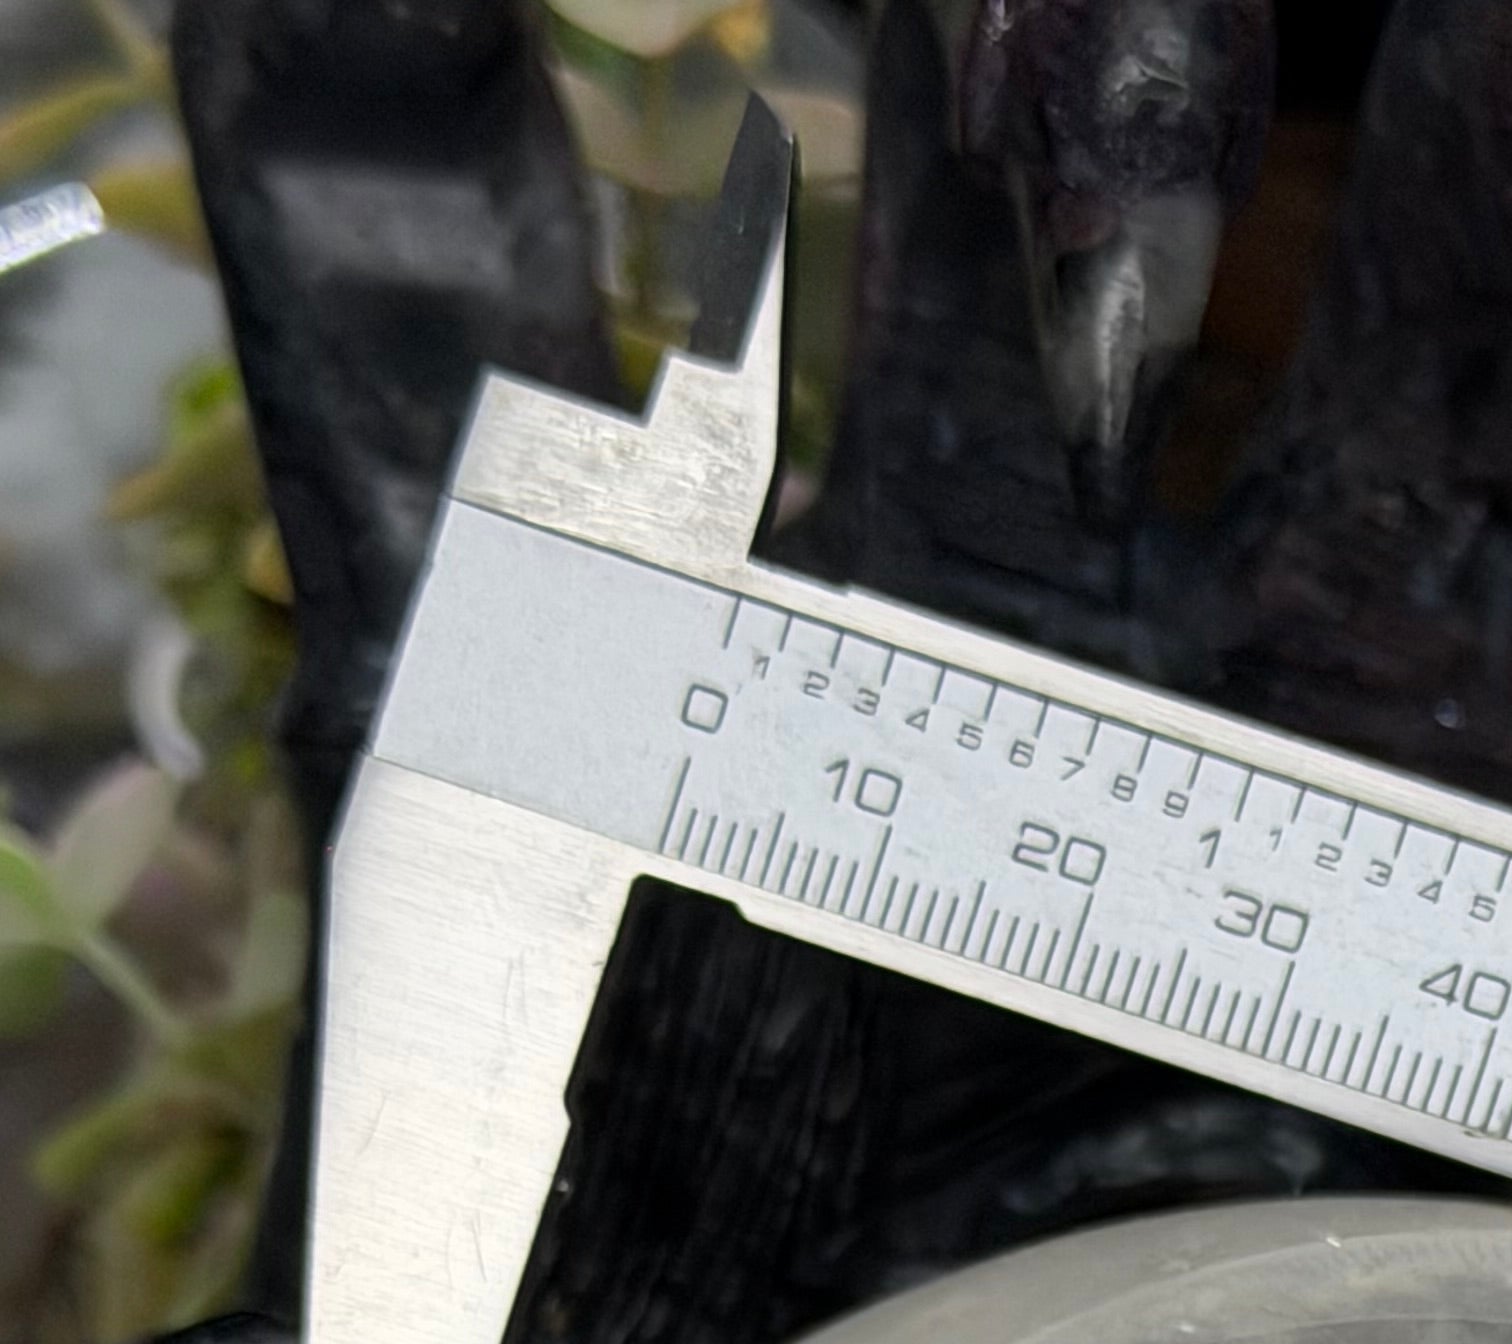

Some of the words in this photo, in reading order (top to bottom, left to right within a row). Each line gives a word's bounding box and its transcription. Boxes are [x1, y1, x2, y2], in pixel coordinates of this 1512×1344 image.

[680, 682, 729, 734] 0
[825, 757, 903, 818] 10
[1010, 820, 1107, 887] 20
[1214, 889, 1311, 954] 30
[1419, 962, 1512, 1021] 40
[753, 654, 770, 679] 1
[802, 670, 830, 699] 2
[852, 687, 880, 716] 3
[904, 708, 930, 733] 4
[955, 722, 983, 751] 5
[1008, 739, 1035, 768] 6
[1061, 756, 1086, 781] 7
[1110, 773, 1138, 802] 8
[1162, 790, 1189, 818] 9
[1199, 827, 1221, 869] 1
[1270, 827, 1282, 851] 1
[1314, 842, 1342, 872] 2
[1364, 859, 1393, 887] 3
[1417, 879, 1443, 904] 4
[1468, 893, 1497, 922] 5
